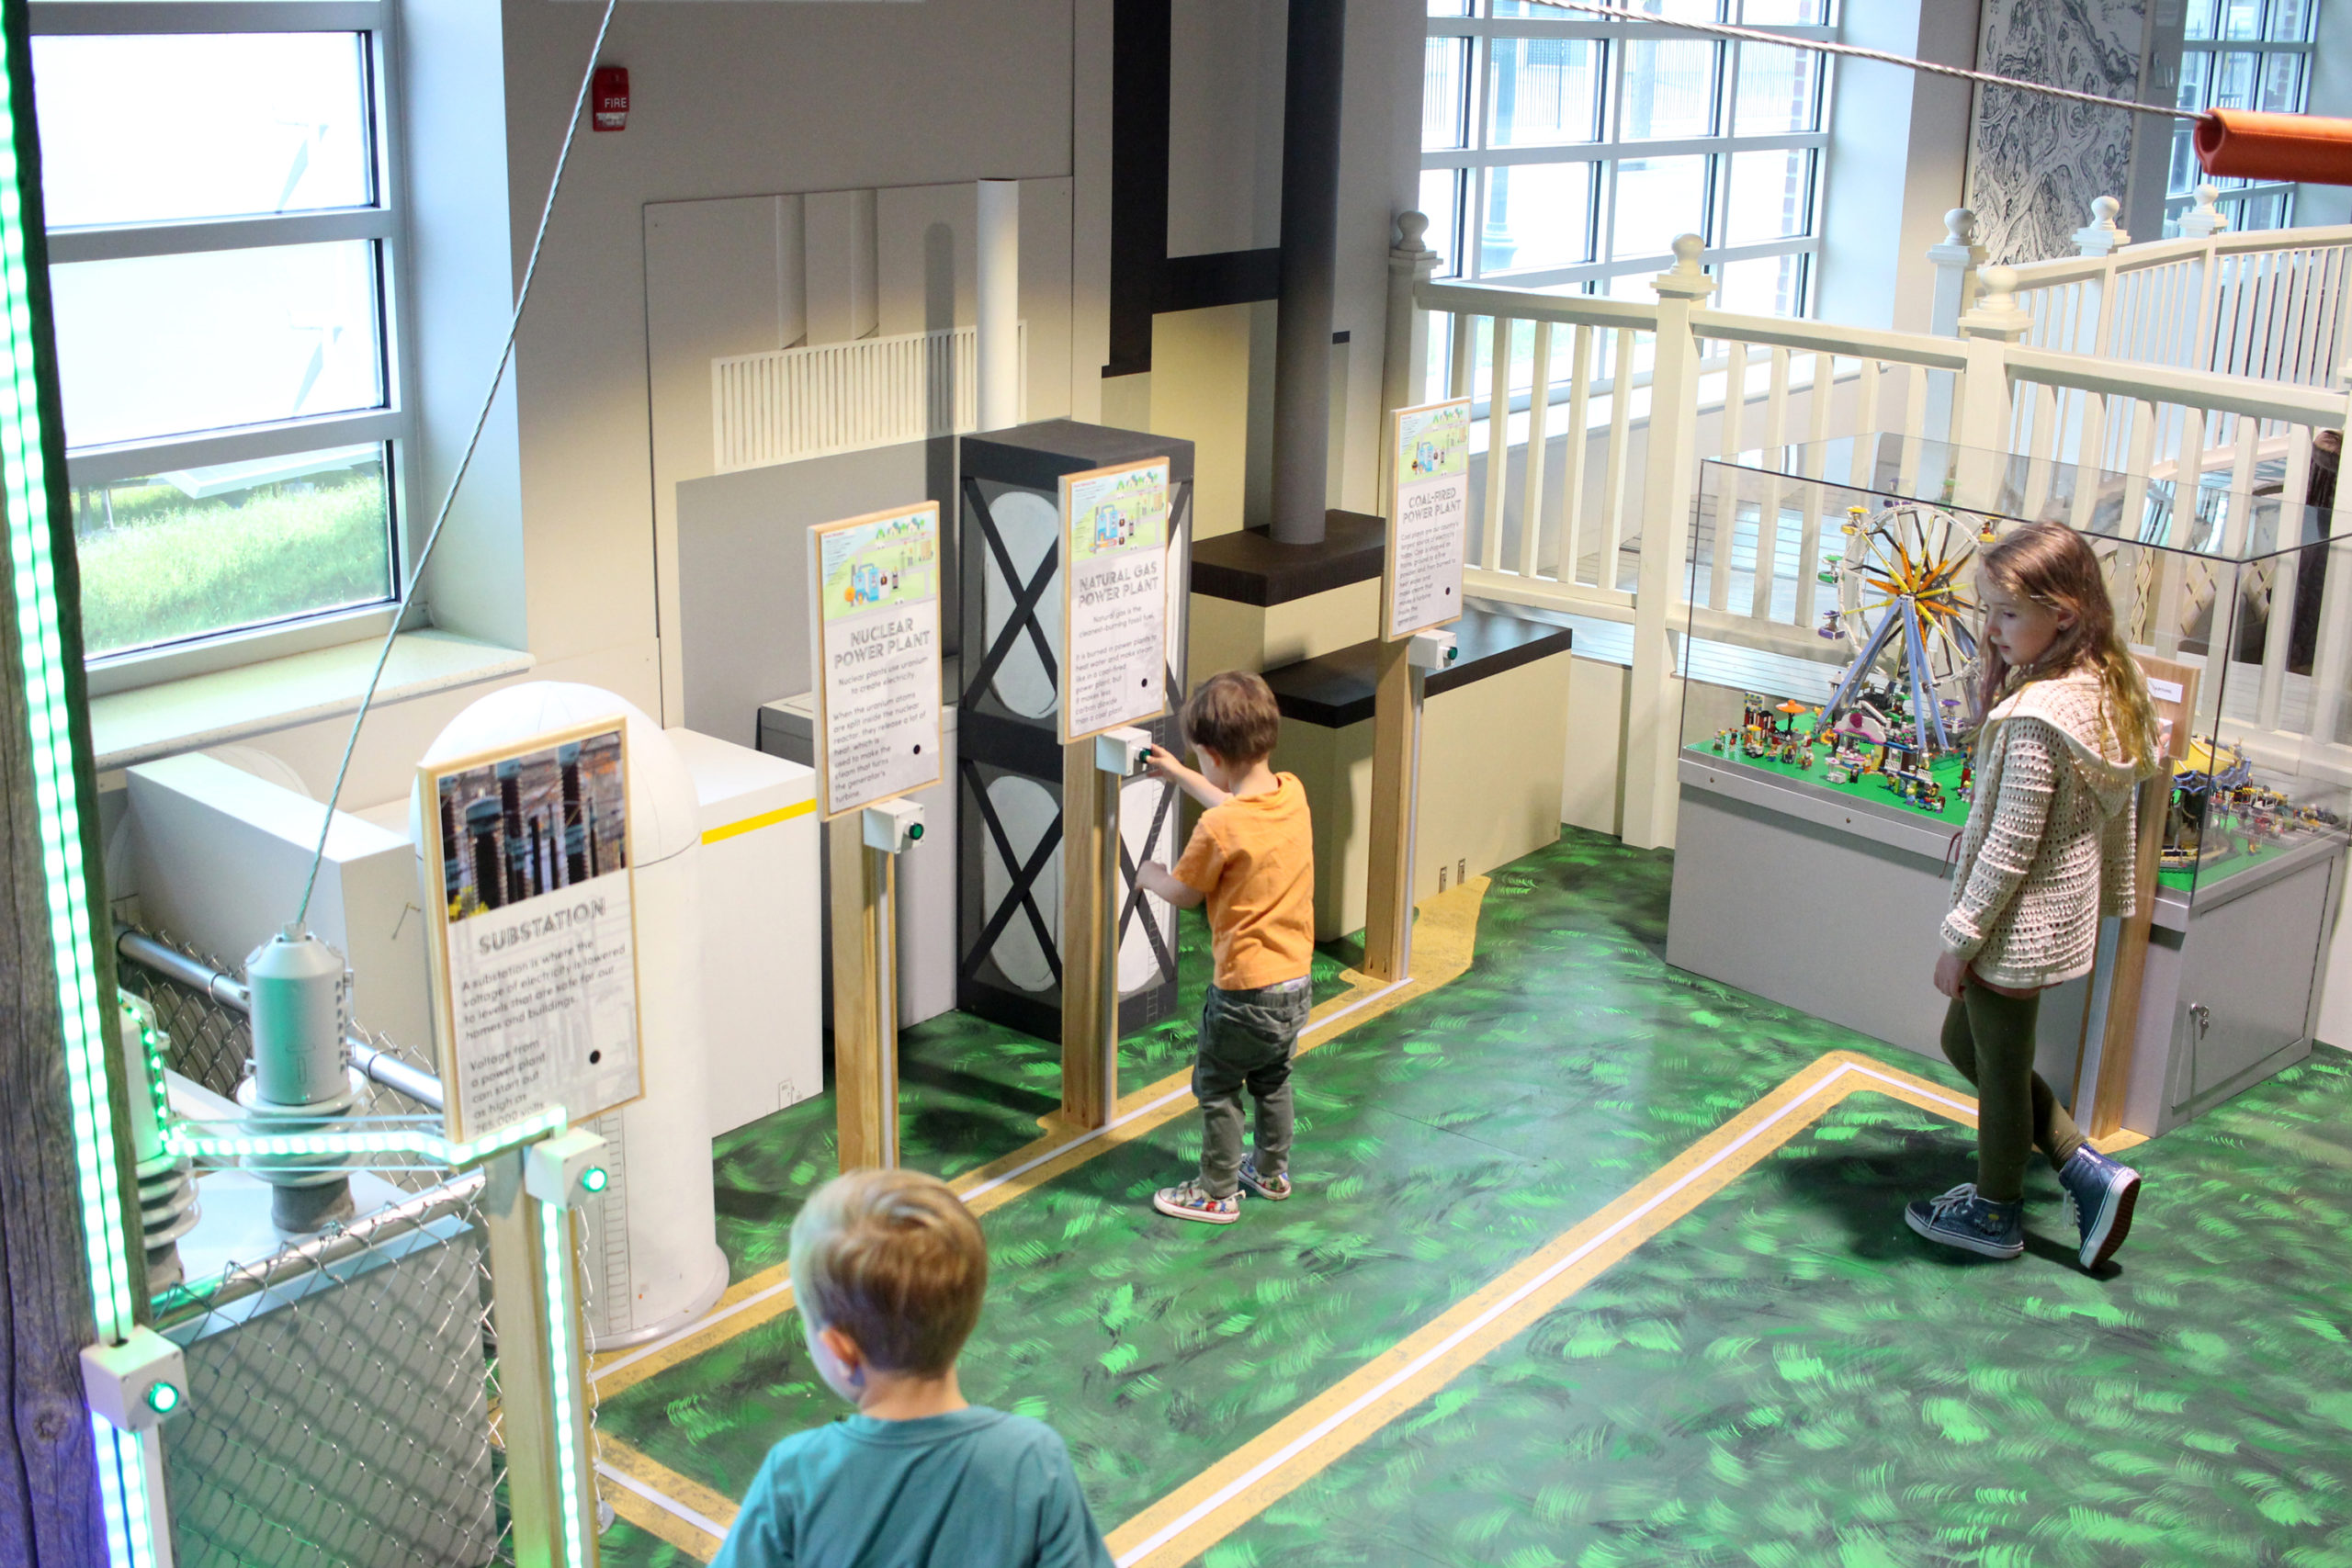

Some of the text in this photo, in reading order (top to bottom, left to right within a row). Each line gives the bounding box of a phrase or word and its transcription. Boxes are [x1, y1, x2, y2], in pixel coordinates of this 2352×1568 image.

[604, 97, 627, 108] FIRE
[1403, 499, 1461, 524] POWER PLANT
[1408, 487, 1456, 508] COAL-FIRED
[1080, 561, 1157, 592] NATURAL GAS
[1079, 576, 1159, 607] POWER PLANT
[851, 618, 913, 646] NUCLEAR
[834, 630, 930, 669] POWER PLANT
[838, 657, 928, 685] Nuclear plants use uranium
[859, 682, 881, 693] create
[833, 711, 853, 721] When
[866, 698, 894, 712] uranium
[895, 693, 916, 703] atoms
[833, 725, 845, 733] are
[846, 719, 861, 729] split
[895, 703, 919, 714] nuclear
[878, 719, 902, 730] release
[910, 714, 918, 722] lot
[919, 710, 926, 719] of
[834, 757, 851, 768] used
[860, 750, 878, 760] make
[880, 746, 891, 754] the
[853, 739, 873, 750] which
[834, 759, 889, 780] steam that turns
[847, 771, 886, 789] generator's
[480, 898, 605, 953] SUBSTATION
[461, 941, 594, 992] A substation is where the
[462, 944, 626, 1008] voltage of electricity is lowered
[464, 965, 614, 1024] to levels that are safe for our
[466, 1022, 502, 1039] homes
[504, 1012, 526, 1028] and
[470, 1040, 539, 1071] Voltage from
[470, 1053, 545, 1089] a power plant
[472, 1070, 539, 1103] can start out
[474, 1093, 527, 1119] as high as
[521, 1101, 545, 1116] volts
